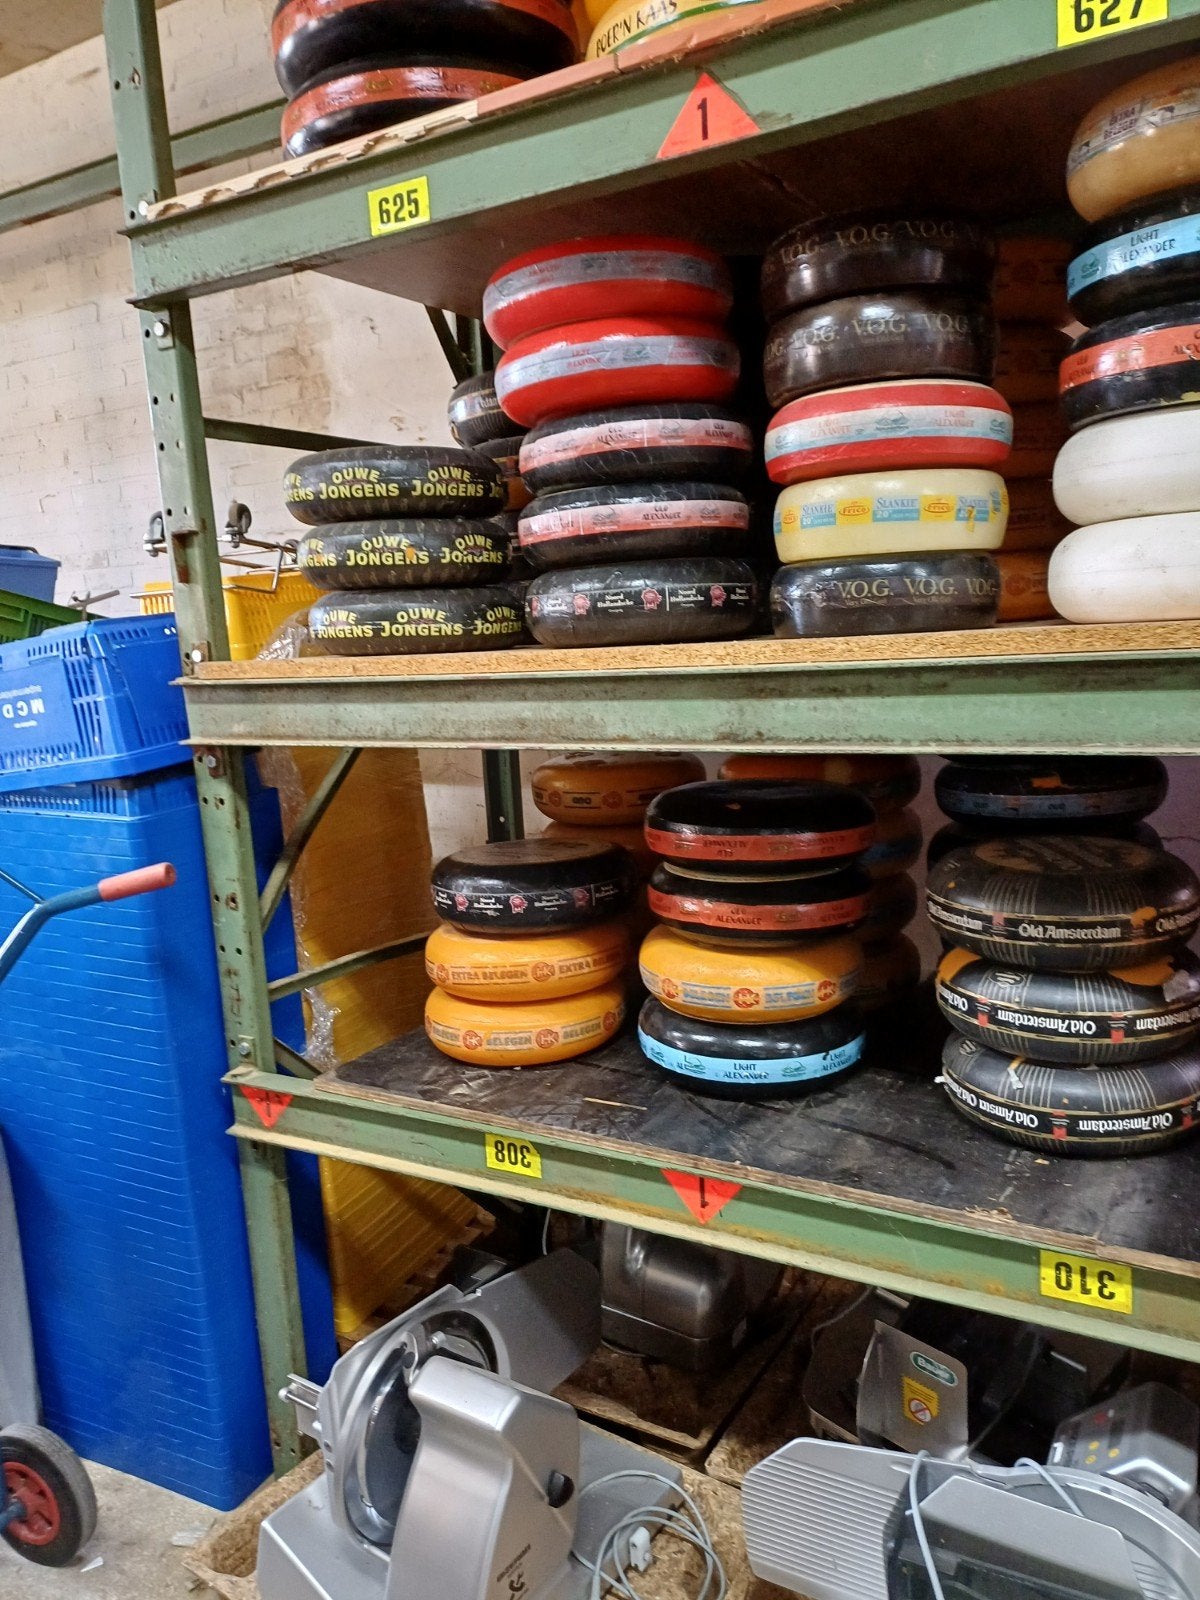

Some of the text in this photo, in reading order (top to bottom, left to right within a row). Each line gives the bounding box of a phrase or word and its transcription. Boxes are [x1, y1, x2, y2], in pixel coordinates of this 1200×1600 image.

[697, 97, 709, 141] 1
[378, 188, 421, 225] 625
[1130, 229, 1160, 247] LIGHT
[331, 466, 381, 484] OUWE
[427, 466, 472, 483] OUWE
[318, 481, 400, 499] JONGENS
[411, 480, 484, 497] JONGENS
[360, 535, 411, 551] OUWE
[455, 534, 493, 550] OUWE
[903, 578, 959, 596] V.O.G.
[323, 609, 358, 625] OUWE
[396, 607, 447, 623] OUWE
[486, 606, 517, 621] OUWE
[380, 621, 463, 637] JONGENS
[1018, 921, 1121, 939] Old Amsterdam
[997, 1009, 1097, 1035] Old Amsterdam
[723, 1071, 770, 1080] ALEXANDER
[733, 1062, 757, 1071] LIGHT
[1015, 1110, 1038, 1128] Old
[1077, 1111, 1174, 1131] Old Amsterdam
[494, 1140, 531, 1168] 308
[699, 1177, 709, 1209] 1
[1055, 1261, 1116, 1300] 310
